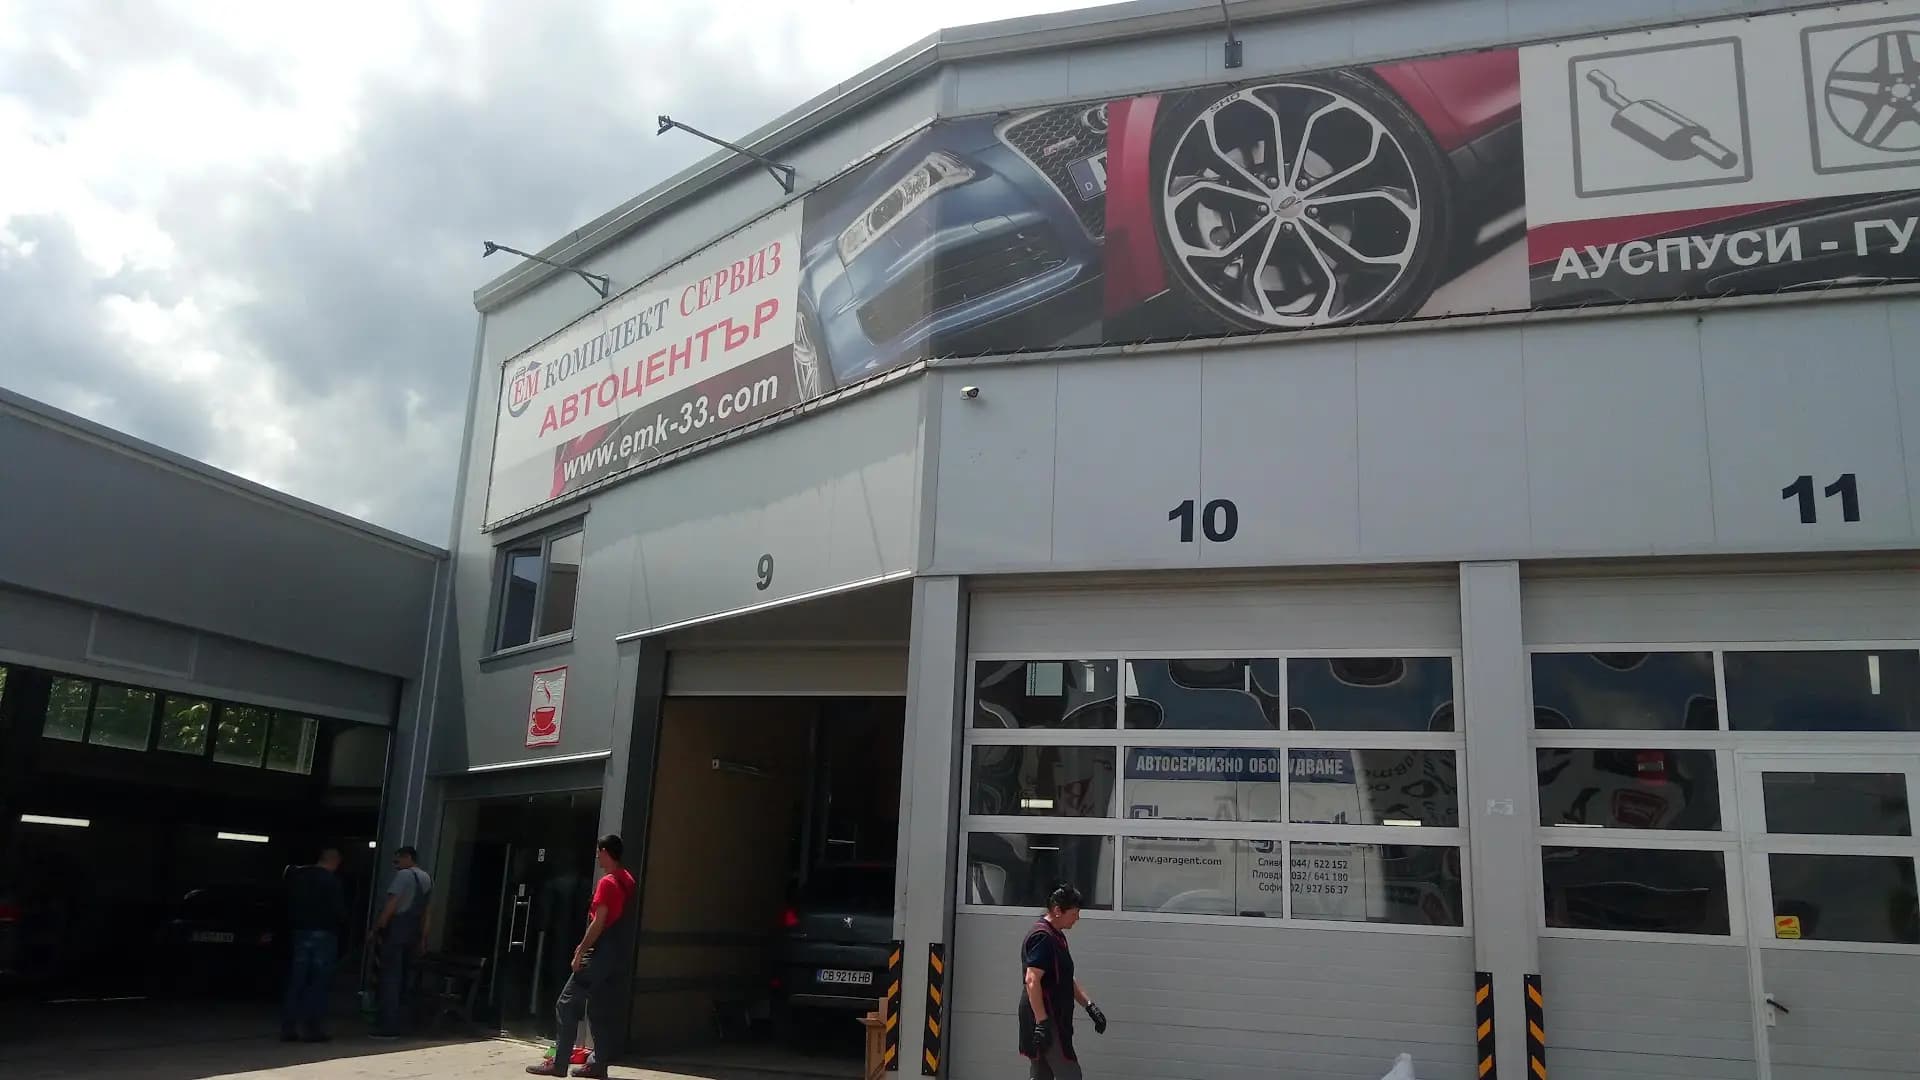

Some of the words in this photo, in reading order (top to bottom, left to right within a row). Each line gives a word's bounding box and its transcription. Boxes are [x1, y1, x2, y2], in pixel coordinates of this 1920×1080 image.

[1084, 182, 1094, 191] D
[1551, 226, 1803, 282] АУСПУСИ
[1820, 241, 1840, 251] -
[1854, 216, 1919, 257] ГУ
[543, 298, 670, 391] КОМПЛЕКТ
[679, 241, 782, 318] СЕРВИЗ
[538, 298, 780, 438] АВТОЦЕНТЪР
[562, 375, 779, 483] www.emk-33.com
[1782, 473, 1861, 523] 11
[1168, 499, 1239, 543] 10
[756, 553, 774, 591] 9
[1136, 755, 1243, 773] АВТОСЕРВИЗНО
[1249, 757, 1344, 776] ОБОУДВАНЕ
[1129, 855, 1223, 866] www.garagent.com
[1258, 857, 1281, 867] Слив
[1314, 859, 1329, 869] 622
[1332, 860, 1348, 869] 152
[1252, 869, 1281, 880] Пловд
[1314, 872, 1329, 881] 641
[1333, 872, 1348, 882] 180
[1258, 882, 1282, 894] Софи
[1325, 885, 1336, 894] 56
[1337, 886, 1348, 894] 37
[836, 971, 857, 982] 9216
